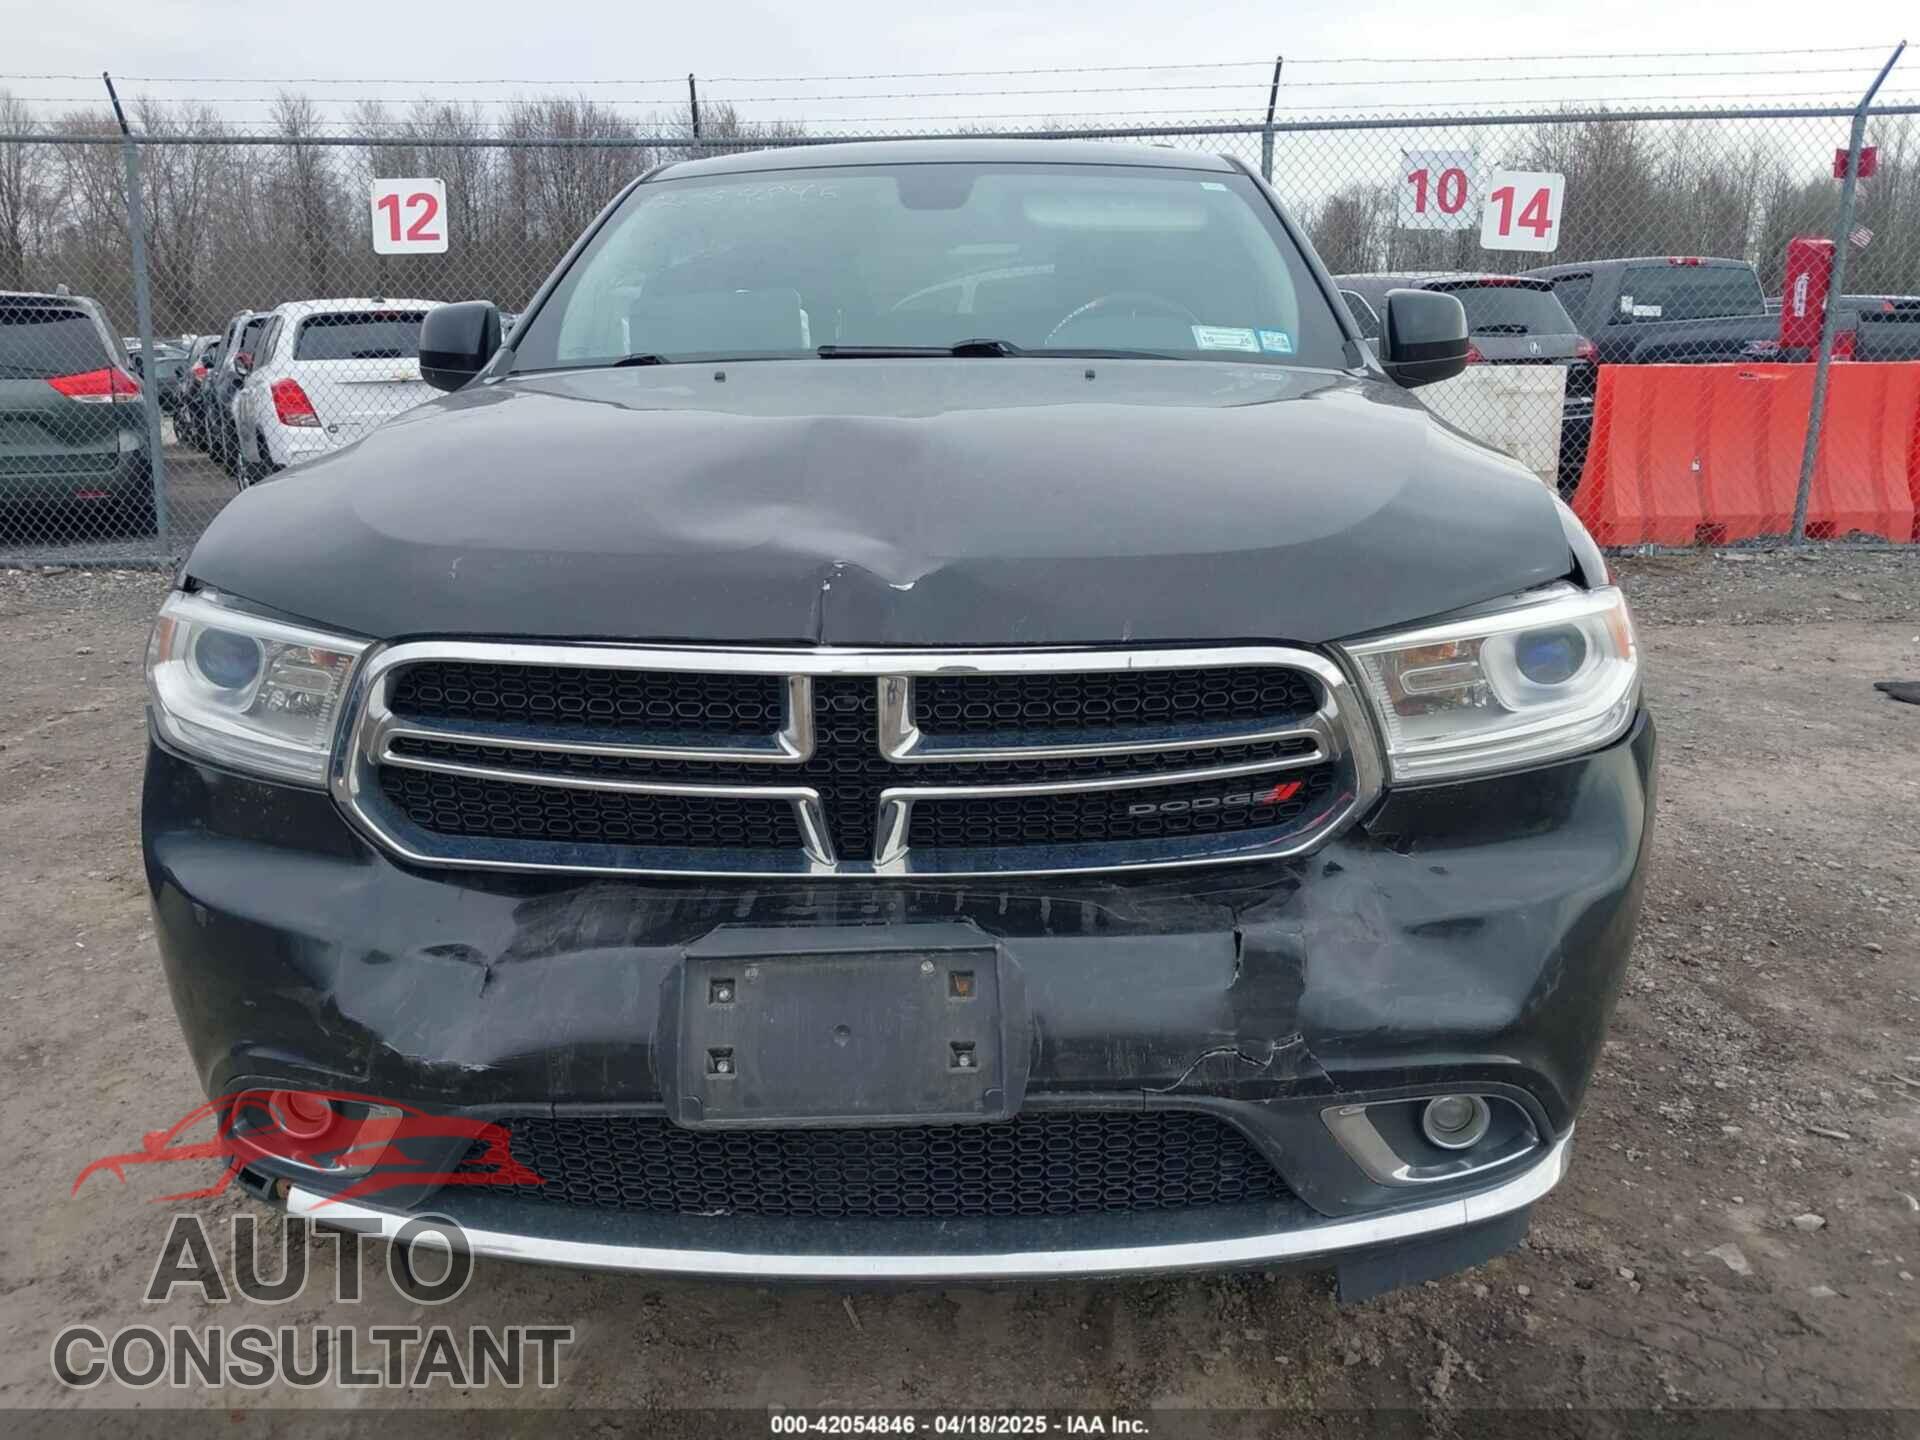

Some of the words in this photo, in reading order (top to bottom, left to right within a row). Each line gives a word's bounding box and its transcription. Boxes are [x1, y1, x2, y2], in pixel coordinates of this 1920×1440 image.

[1407, 168, 1468, 214] 10
[1491, 186, 1553, 238] 14
[377, 192, 441, 242] 12
[1128, 789, 1279, 815] DODGE
